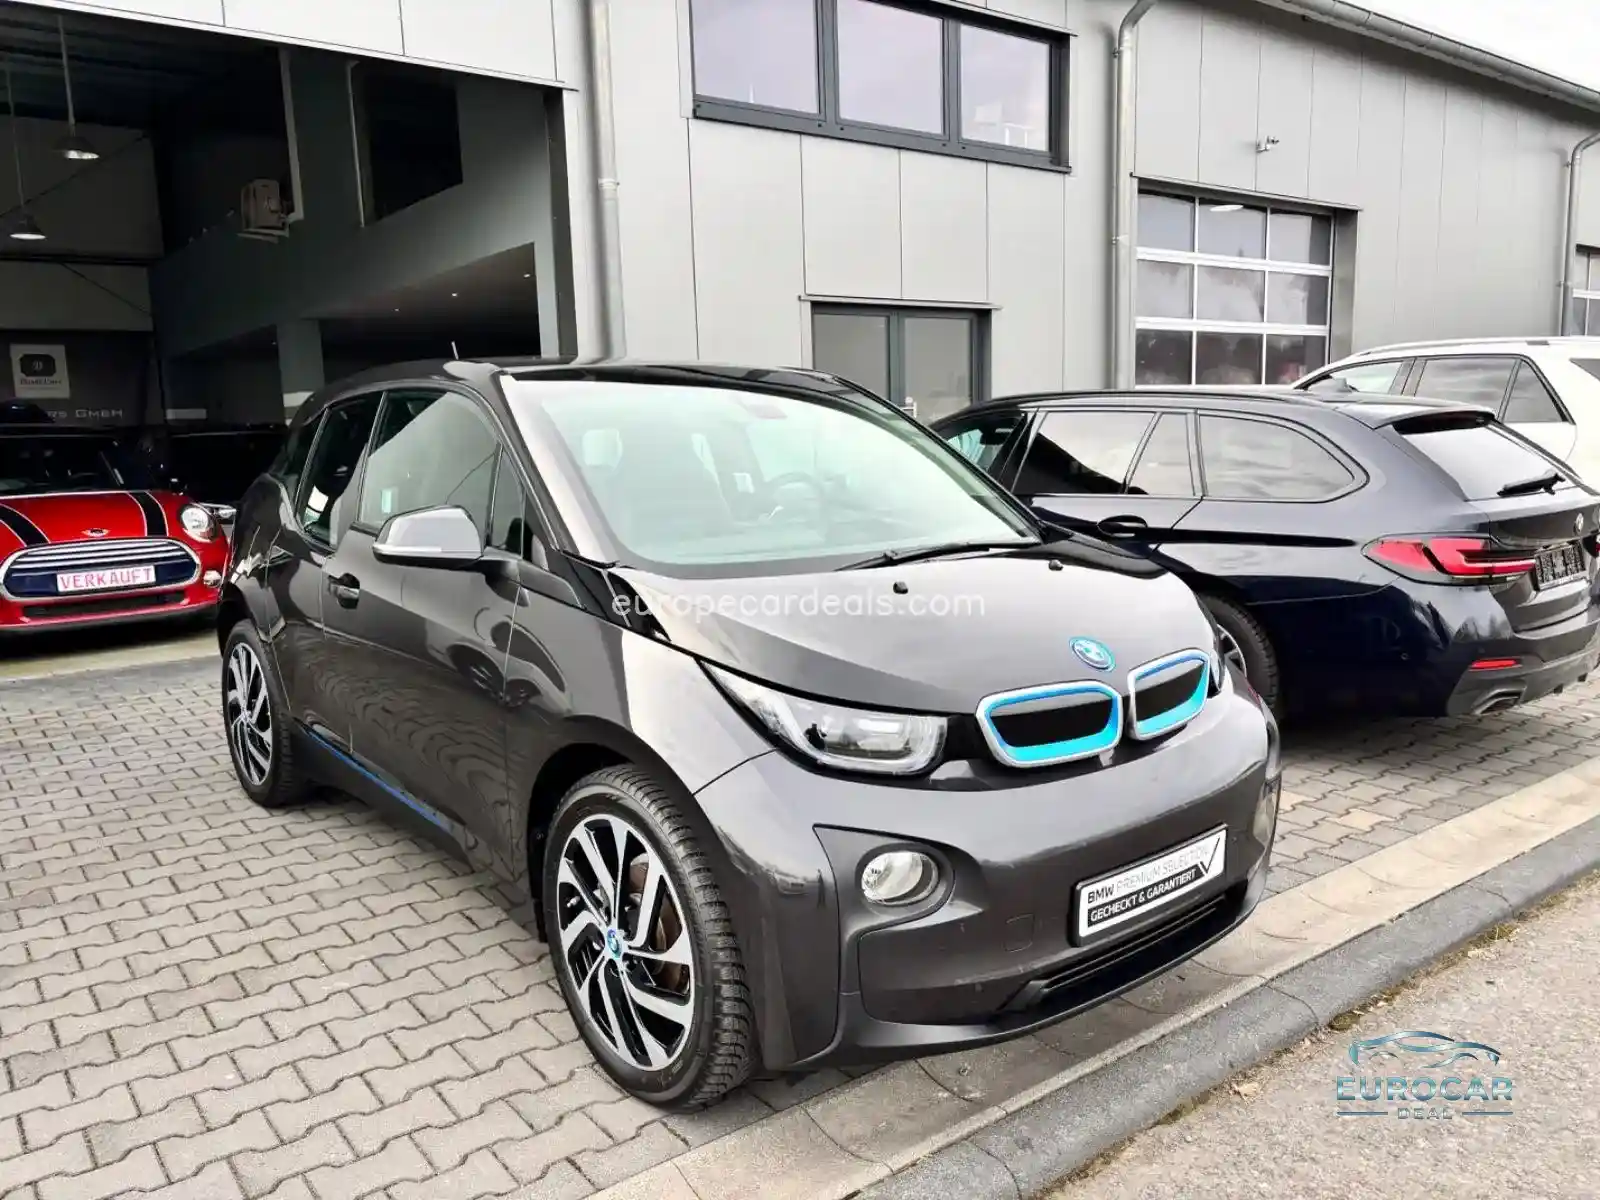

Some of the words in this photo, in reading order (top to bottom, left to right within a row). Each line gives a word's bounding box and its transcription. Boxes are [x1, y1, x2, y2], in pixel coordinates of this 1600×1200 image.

[61, 567, 153, 590] VERKAUFT
[1087, 883, 1115, 904] BMW
[1090, 895, 1137, 922] GECHECKT
[1146, 868, 1197, 898] GARANTIERT
